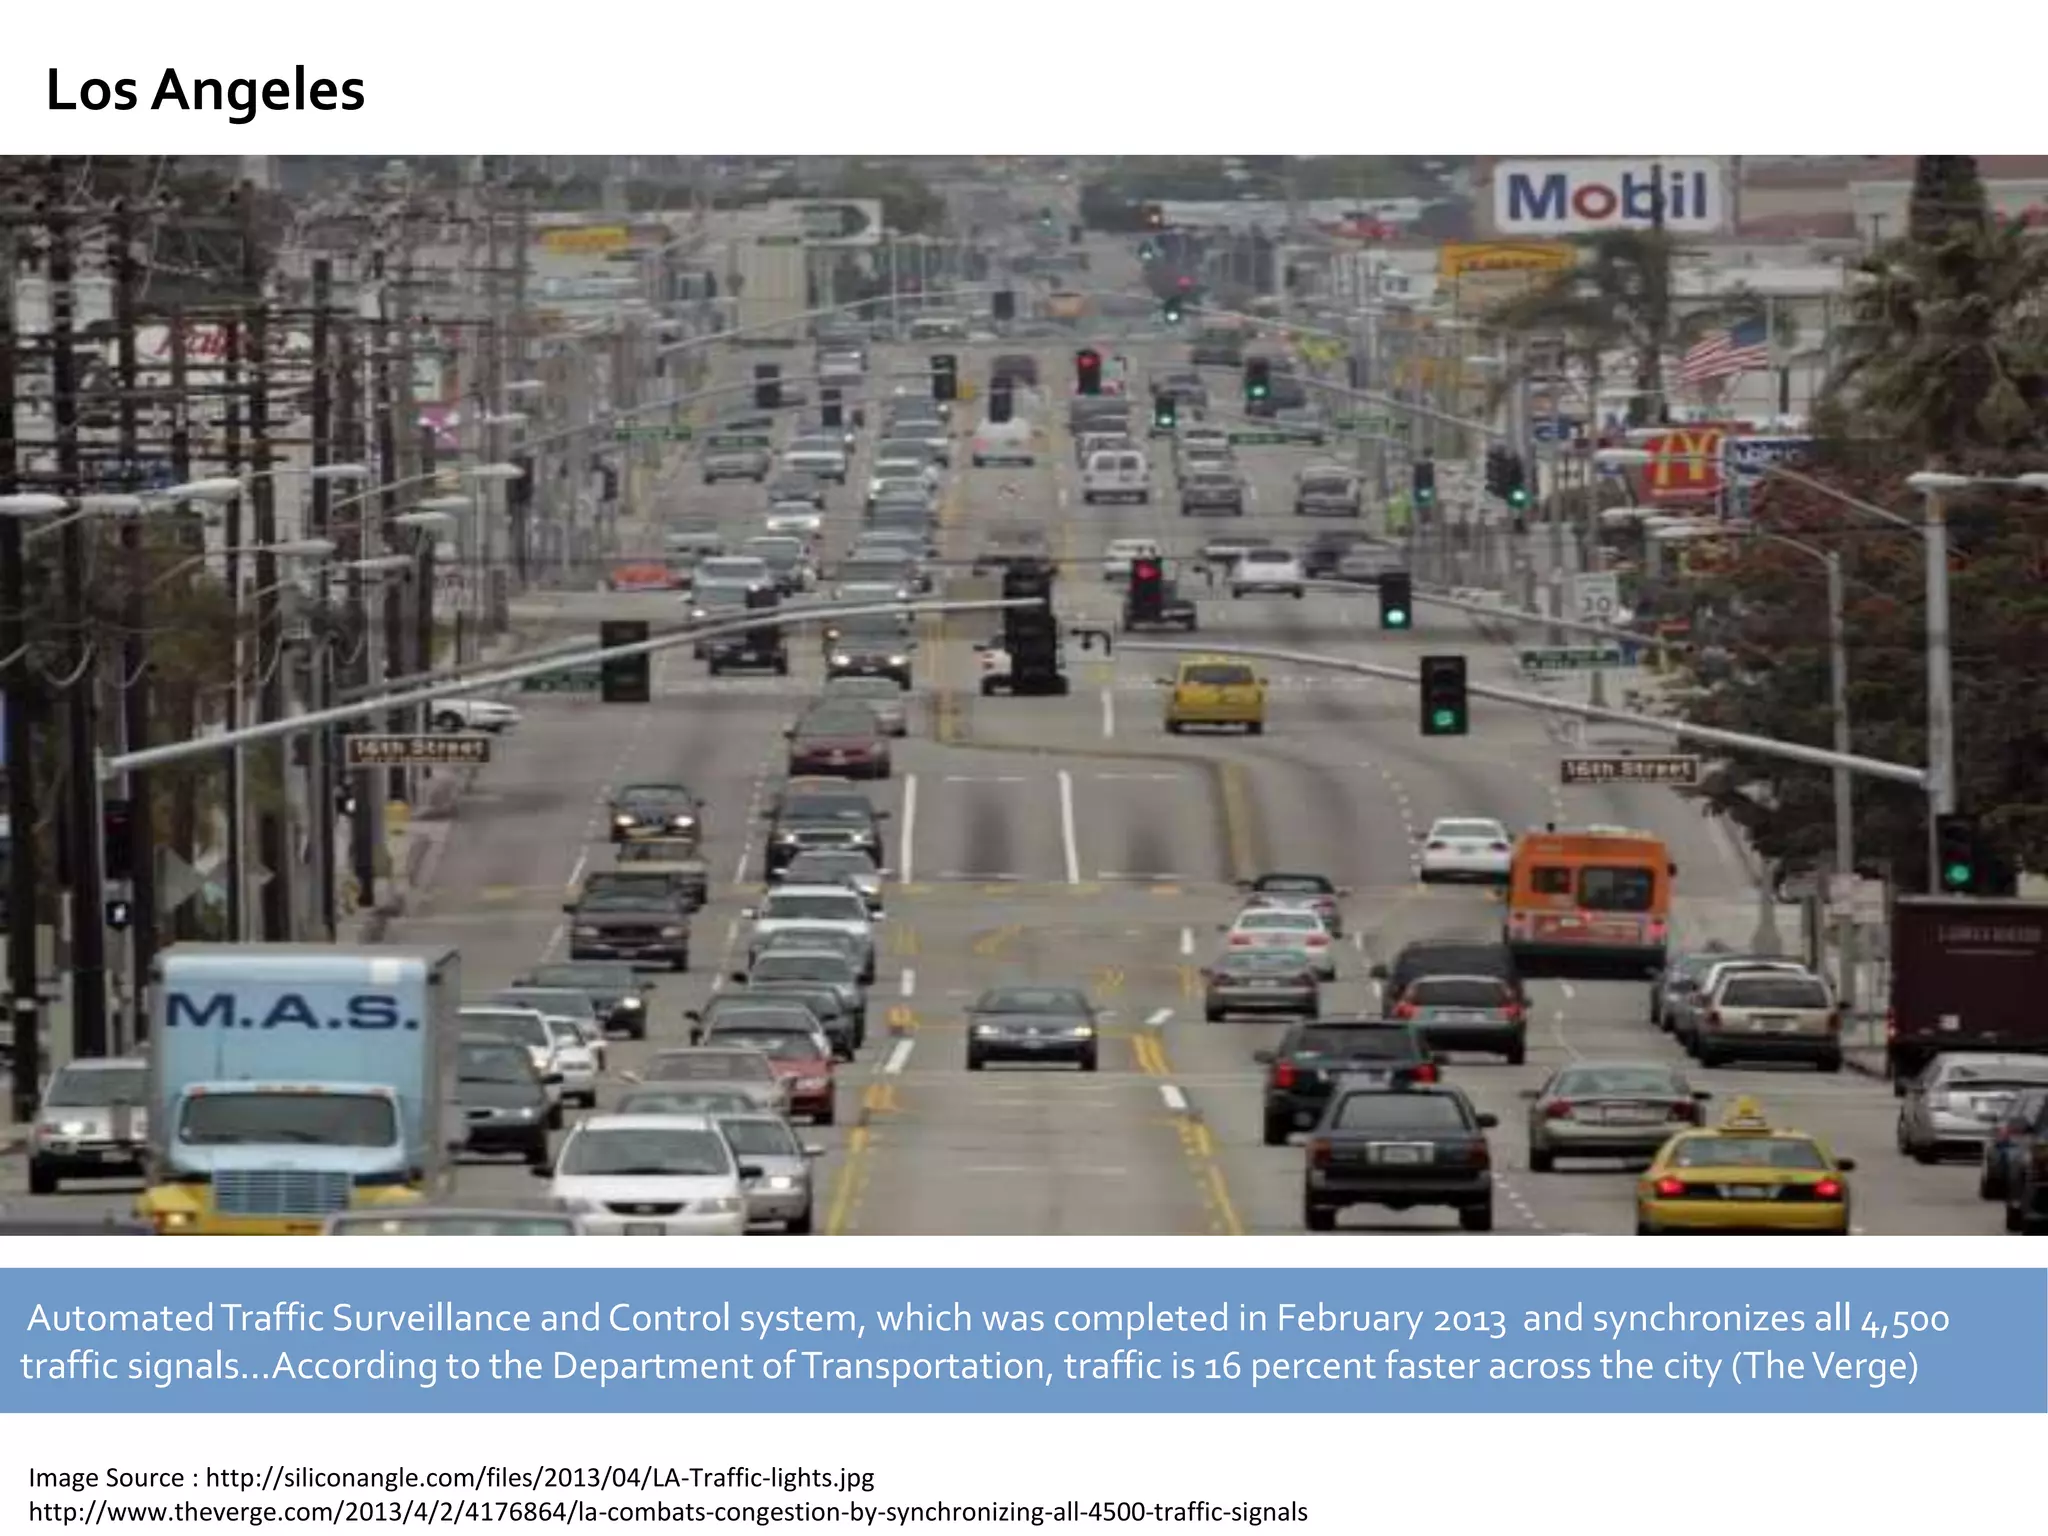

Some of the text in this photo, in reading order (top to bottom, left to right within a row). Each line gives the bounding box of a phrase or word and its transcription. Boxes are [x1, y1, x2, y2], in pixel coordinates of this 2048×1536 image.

[1508, 170, 1707, 220] Mobil
[1621, 761, 1691, 776] Street
[166, 993, 419, 1030] M.A.S.
